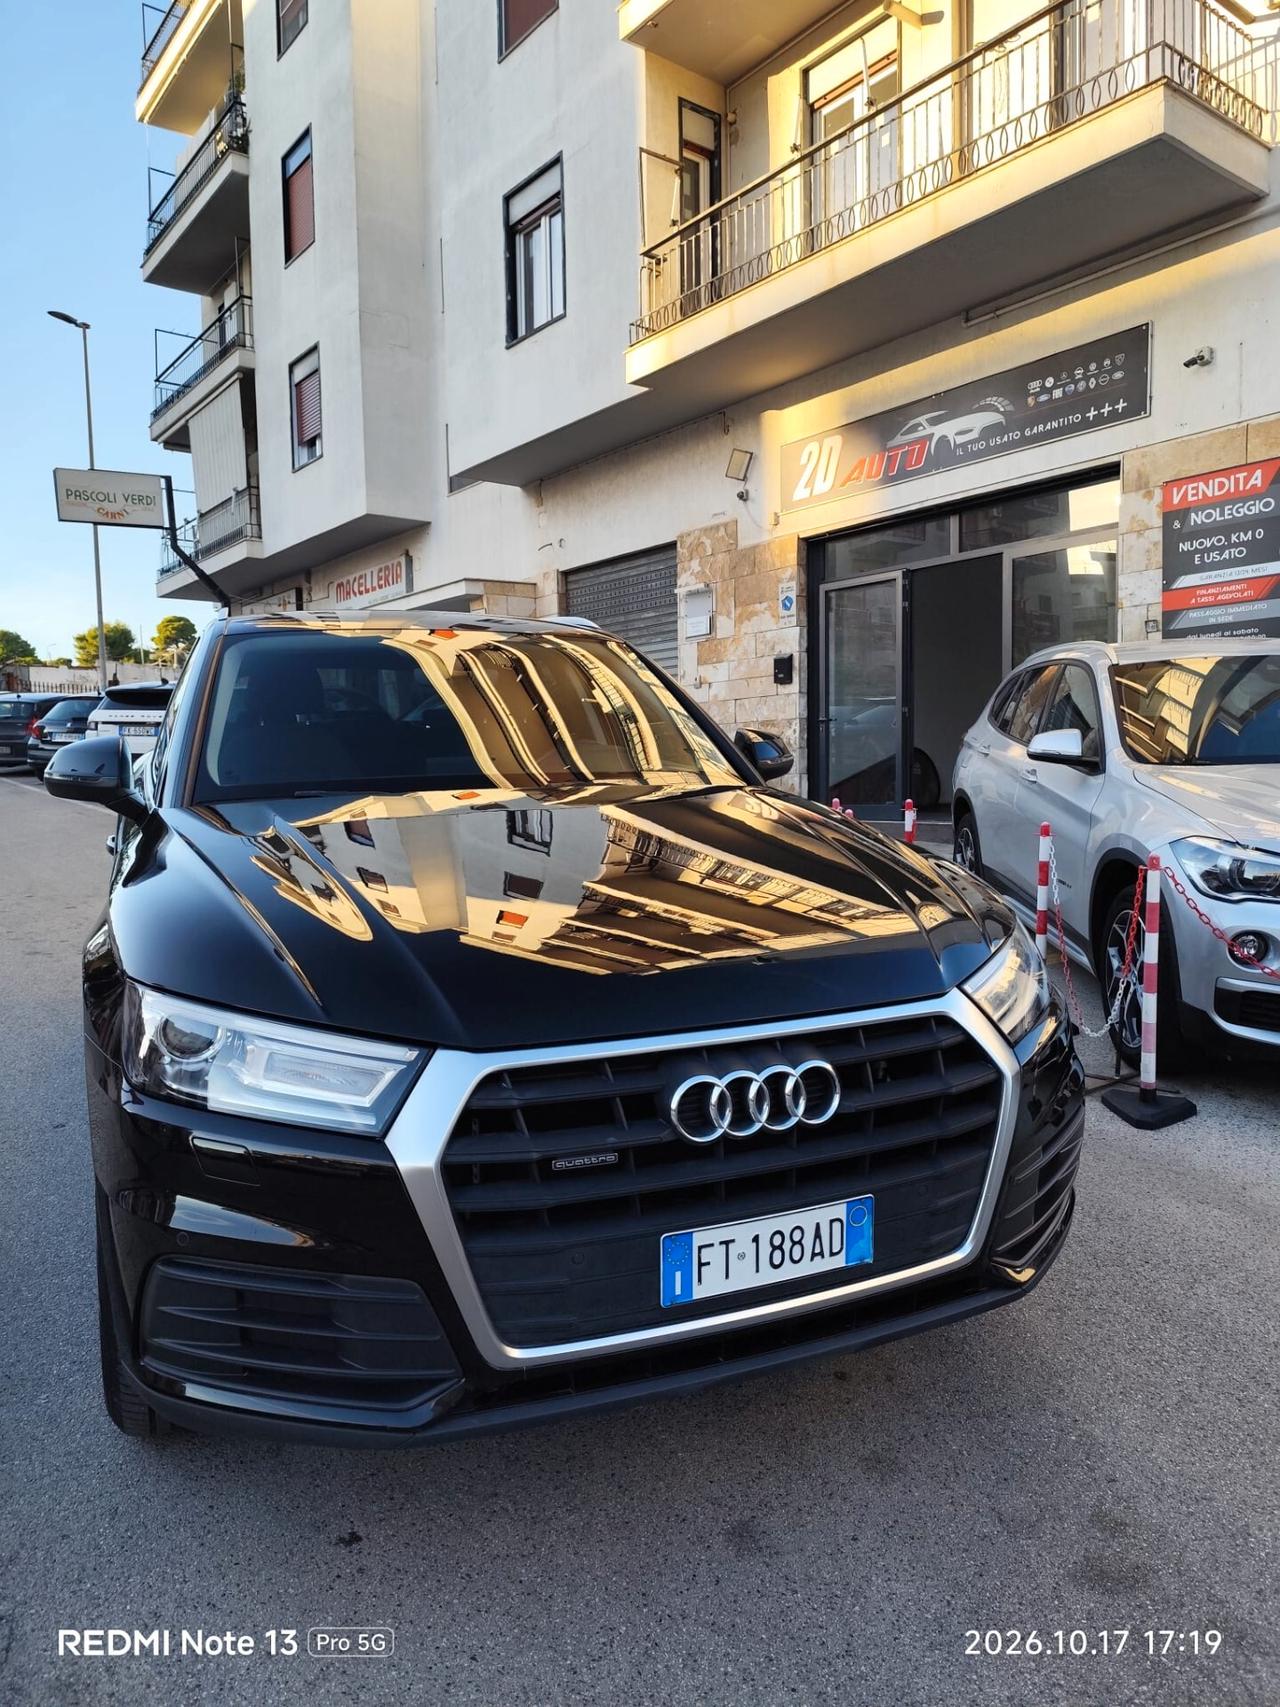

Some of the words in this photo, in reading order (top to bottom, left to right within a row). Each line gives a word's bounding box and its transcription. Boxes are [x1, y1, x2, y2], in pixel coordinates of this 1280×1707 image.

[956, 448, 964, 456] IL
[967, 441, 986, 452] TUO
[989, 431, 1021, 447] USATO
[1025, 414, 1082, 436] GARANTITO
[792, 434, 842, 501] 2D
[840, 438, 929, 489] AUTO
[1172, 469, 1262, 505] VENDITA
[65, 488, 117, 503] PASCOLI
[122, 493, 156, 506] VERDI
[97, 506, 129, 519] CARNI
[1172, 520, 1181, 529] &
[1190, 497, 1275, 526] NOLEGGIO
[1231, 530, 1252, 544] KM
[1255, 528, 1264, 539] 0
[1194, 554, 1201, 564] E
[1204, 547, 1246, 563] USATO
[335, 561, 402, 604] MACELLERIA
[1196, 583, 1247, 595] FINANZIAMENTI
[1197, 595, 1215, 603] TASSI
[1216, 591, 1254, 601] AGEVOLATI
[1189, 608, 1225, 618] PASSAGGIO
[1227, 603, 1267, 613] IMMEDIATO
[1232, 627, 1259, 635] sabato
[556, 1155, 615, 1168] quattro
[697, 1239, 735, 1286] FT
[751, 1217, 844, 1274] 188AD
